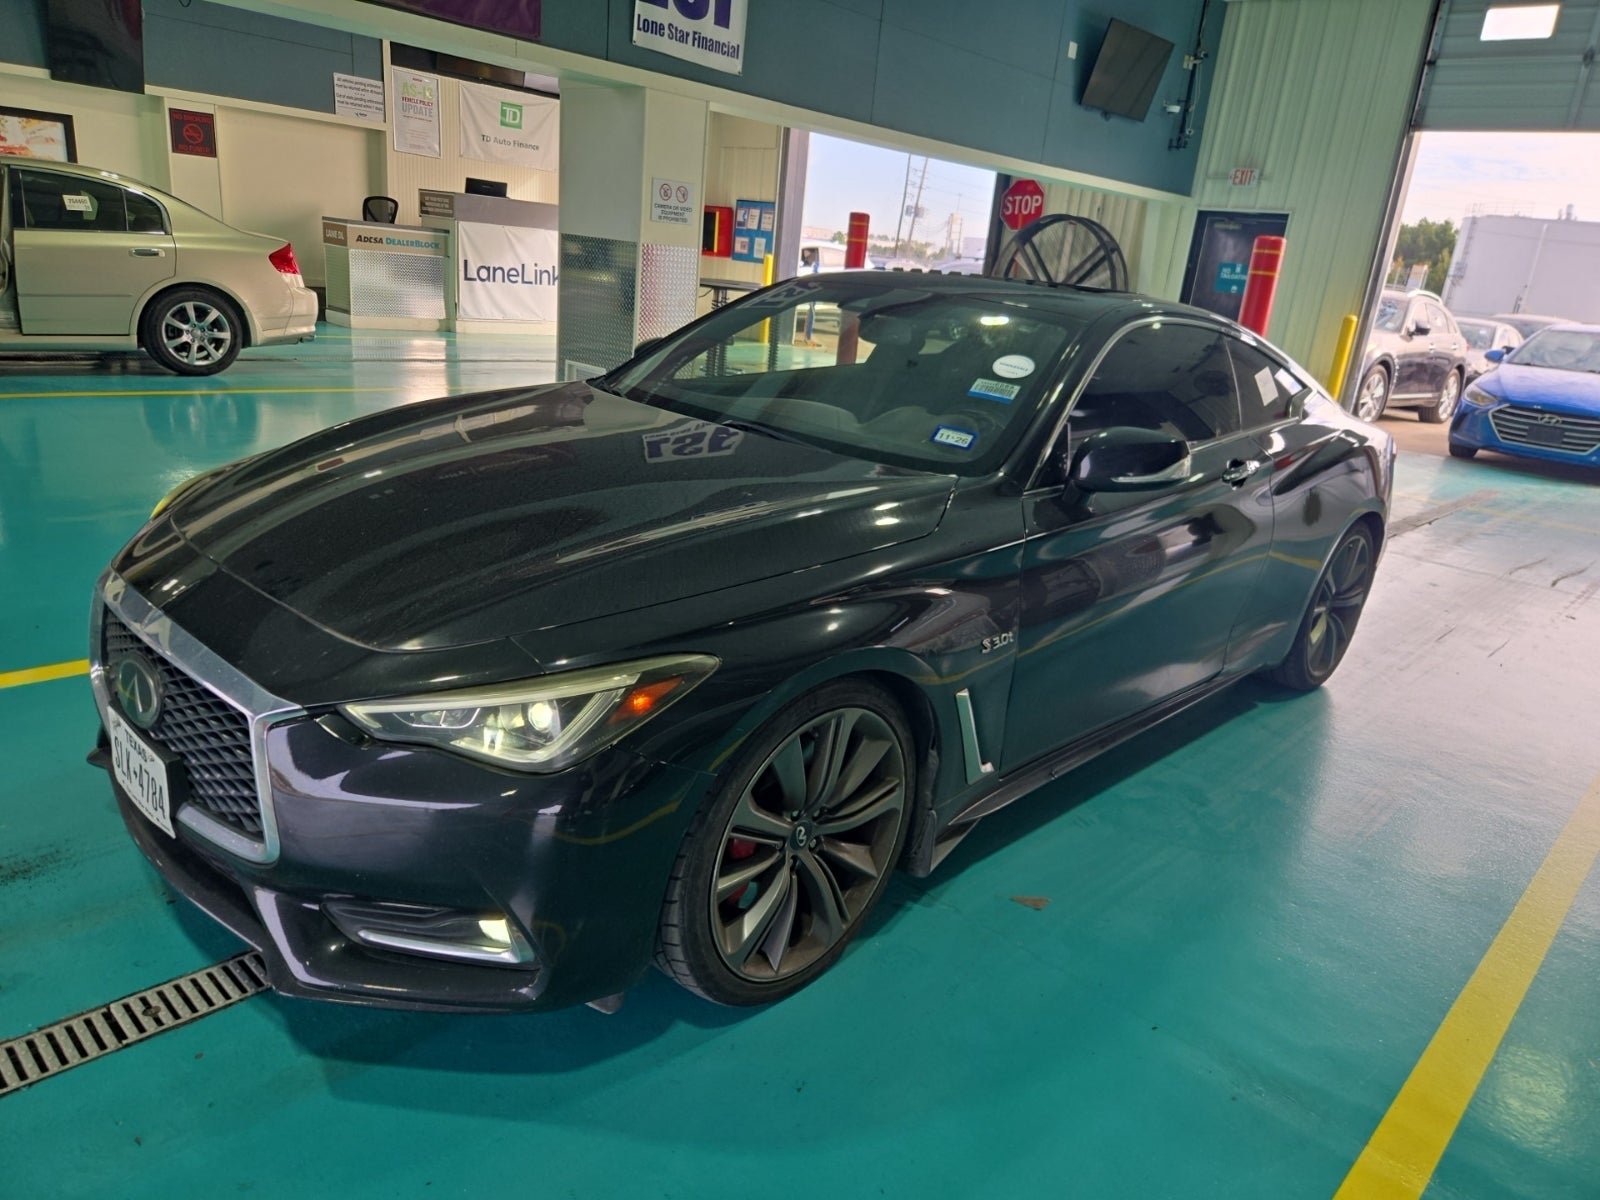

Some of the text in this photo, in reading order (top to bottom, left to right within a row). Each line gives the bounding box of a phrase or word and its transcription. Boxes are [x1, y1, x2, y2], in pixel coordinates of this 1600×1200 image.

[637, 14, 665, 37] Lone
[667, 23, 690, 45] Star
[692, 31, 740, 60] Financial
[401, 96, 433, 107] VEHICLE POLICY
[401, 103, 433, 118] UPDATE
[502, 106, 521, 124] TD
[481, 134, 539, 151] TD Auto Finance
[1231, 168, 1254, 186] EXIT
[661, 209, 685, 217] EQUIPMENT
[1003, 195, 1042, 215] STOP
[355, 234, 440, 250] ADESA DEALERBLOCK
[463, 259, 559, 286] LaneLink
[982, 638, 991, 654] S
[125, 729, 147, 763] TEXAS
